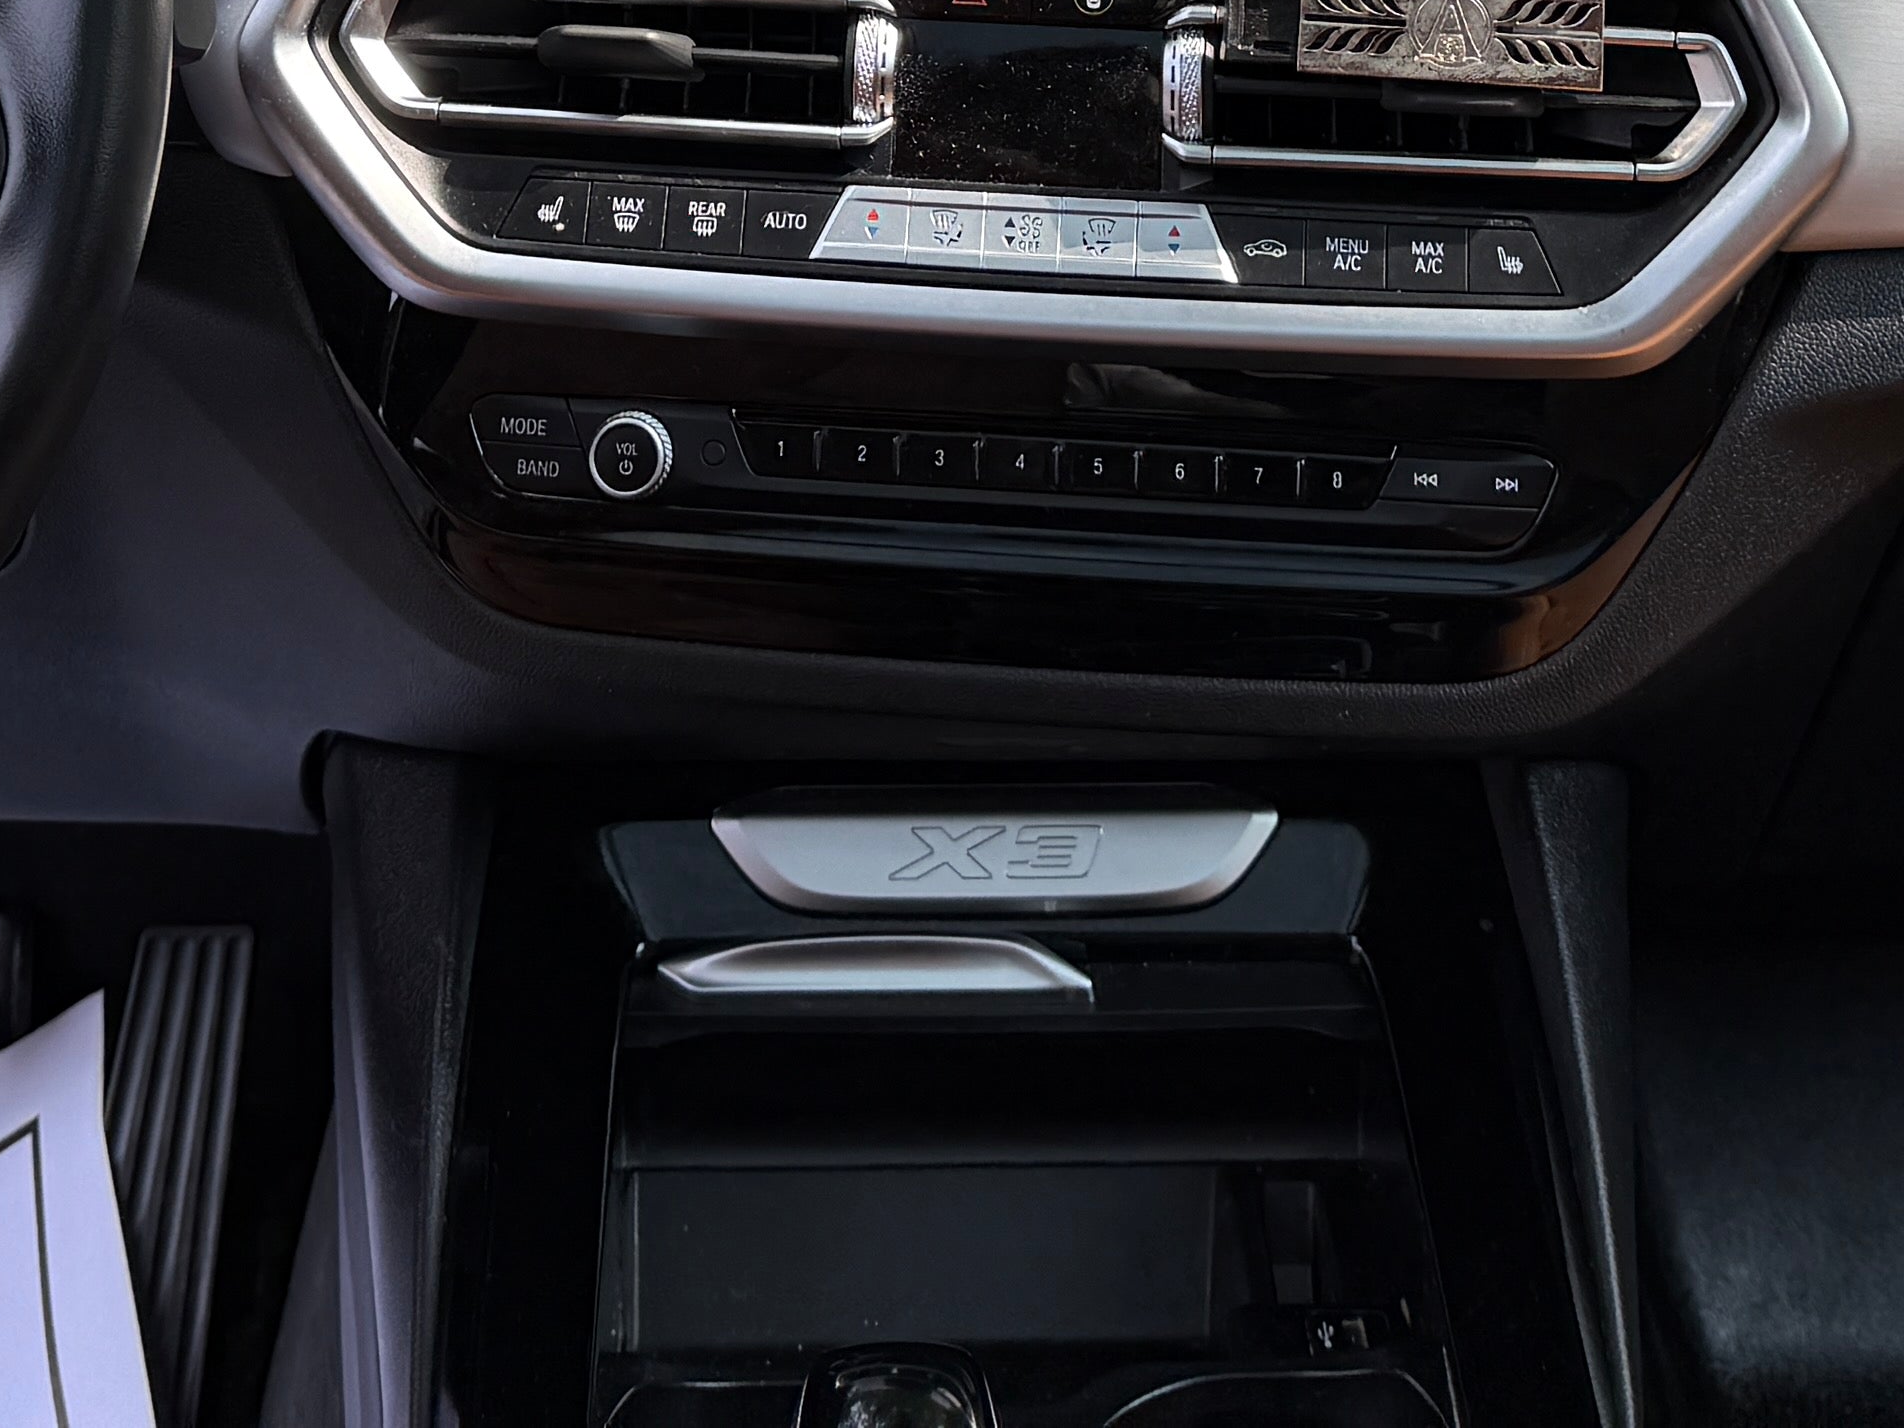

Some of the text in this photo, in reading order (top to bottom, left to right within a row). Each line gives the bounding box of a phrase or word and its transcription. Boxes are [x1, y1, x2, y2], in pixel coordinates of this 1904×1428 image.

[611, 196, 645, 215] MAX
[688, 200, 727, 219] REAR
[763, 211, 808, 231] AUTO
[1324, 236, 1370, 255] MENU
[1410, 239, 1446, 258] MAX
[1332, 254, 1363, 274] A/C
[1413, 256, 1444, 276] A/C
[499, 417, 548, 437] MODE
[615, 442, 639, 457] VOL
[776, 439, 785, 457] 1
[856, 445, 868, 462] 2
[934, 449, 945, 467] 3
[1014, 453, 1026, 471] 4
[1093, 457, 1104, 476] 5
[516, 458, 560, 479] BAND
[1175, 462, 1186, 480] 6
[1254, 467, 1264, 485] 7
[1333, 471, 1343, 489] 8
[887, 823, 1105, 881] X3
